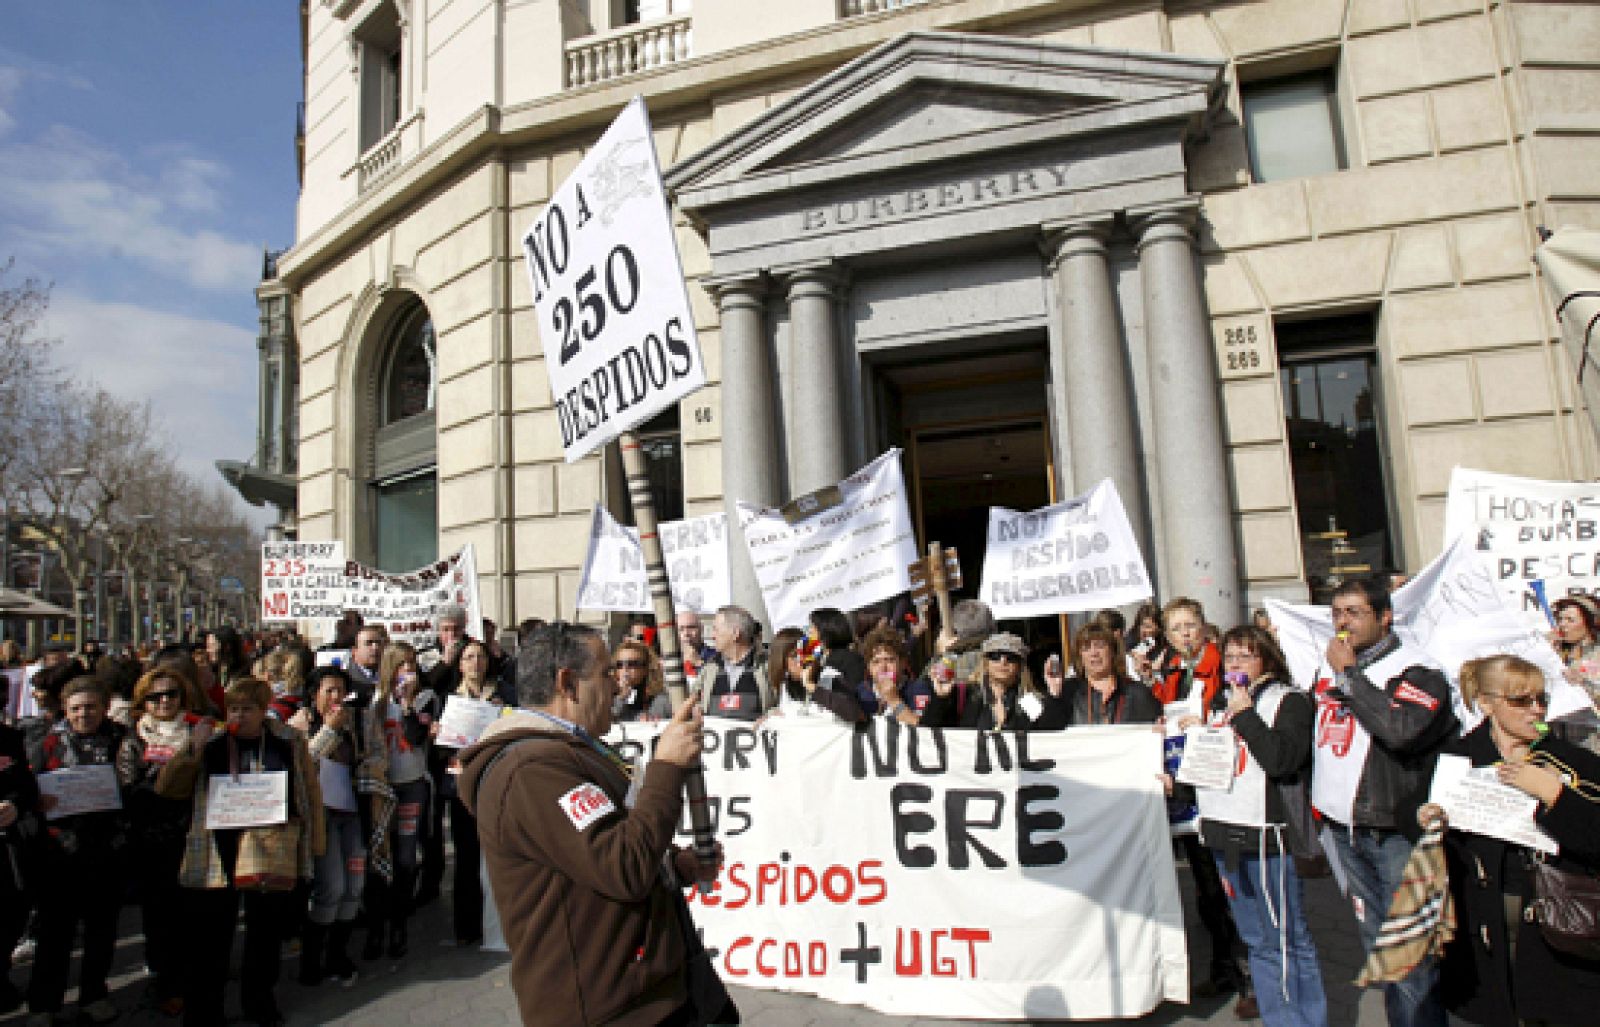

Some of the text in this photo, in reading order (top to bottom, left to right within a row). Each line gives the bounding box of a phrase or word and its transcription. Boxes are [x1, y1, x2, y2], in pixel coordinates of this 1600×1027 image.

[802, 165, 1072, 231] BURBERRY
[523, 183, 594, 303] NO A
[551, 243, 641, 367] 250
[555, 316, 693, 449] DESPIDOS
[264, 592, 289, 617] NO
[991, 560, 1145, 606] MISERABLE
[890, 783, 1068, 870] ERE
[895, 927, 993, 979] UGT
